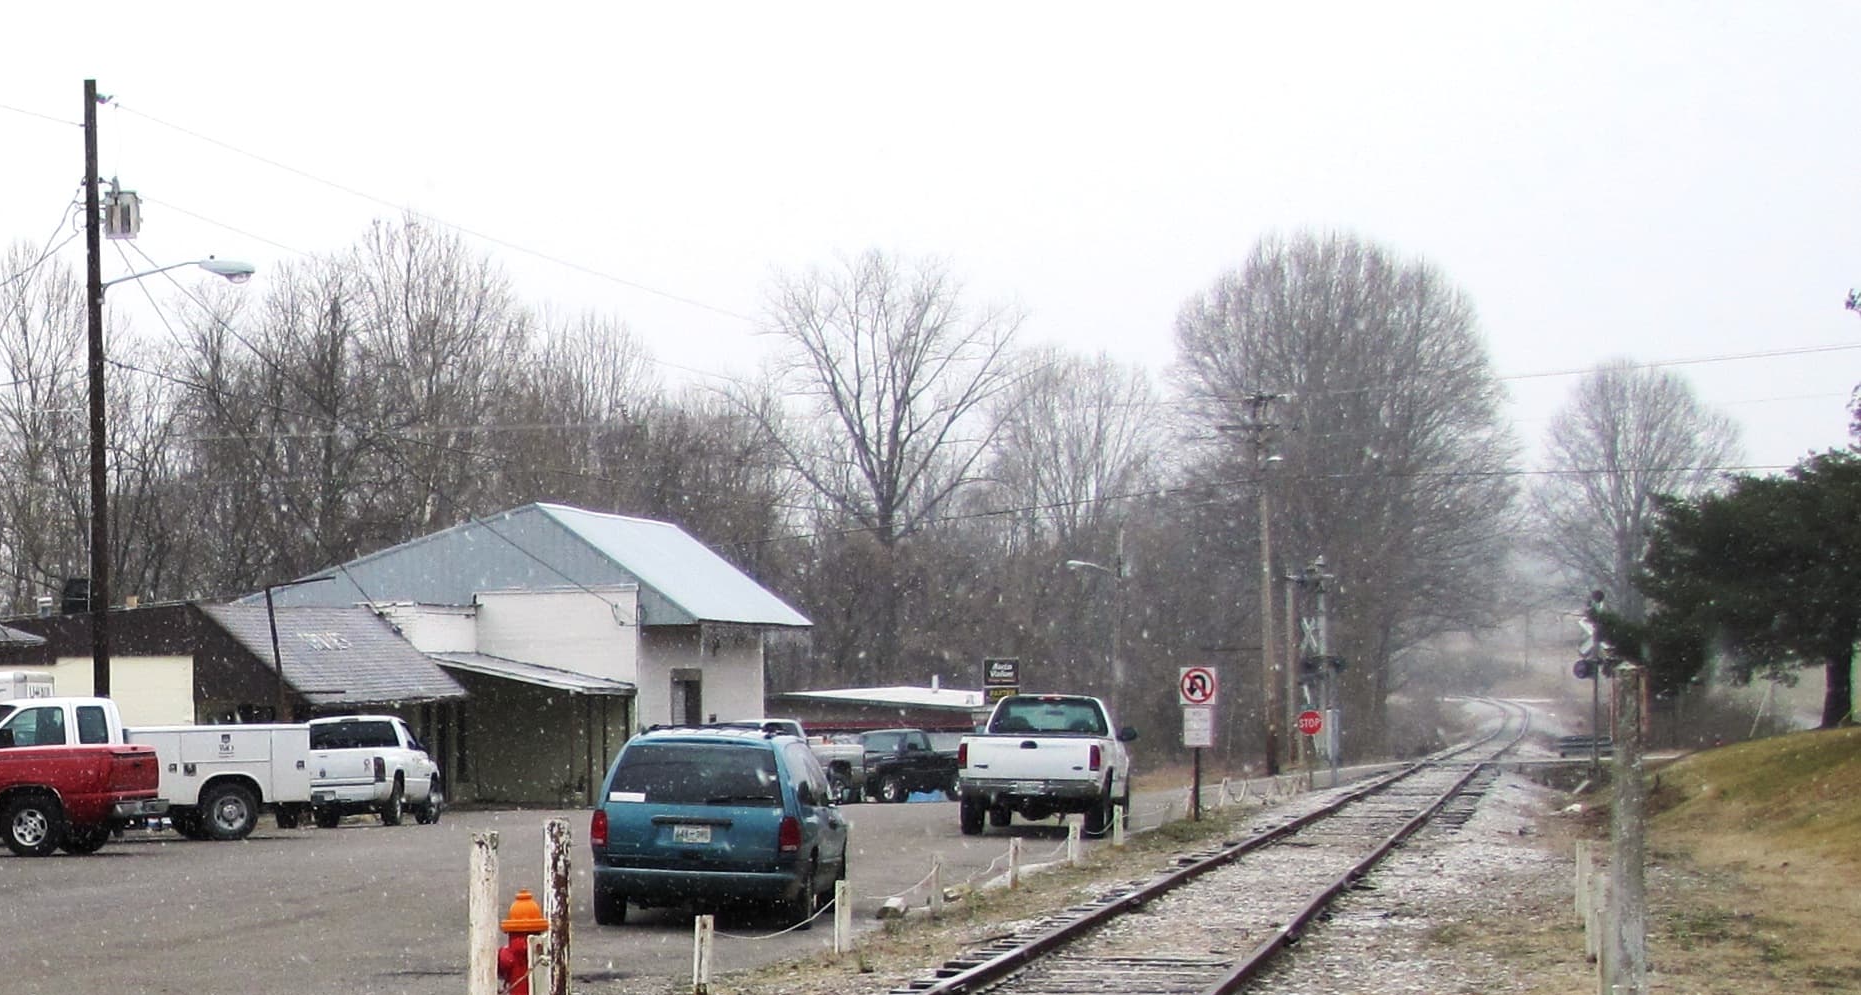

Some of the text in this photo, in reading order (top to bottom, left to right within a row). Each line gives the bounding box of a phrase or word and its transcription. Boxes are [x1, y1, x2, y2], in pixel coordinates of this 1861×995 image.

[992, 662, 1013, 670] Auto
[990, 670, 1015, 678] Value
[1299, 718, 1320, 729] STOP
